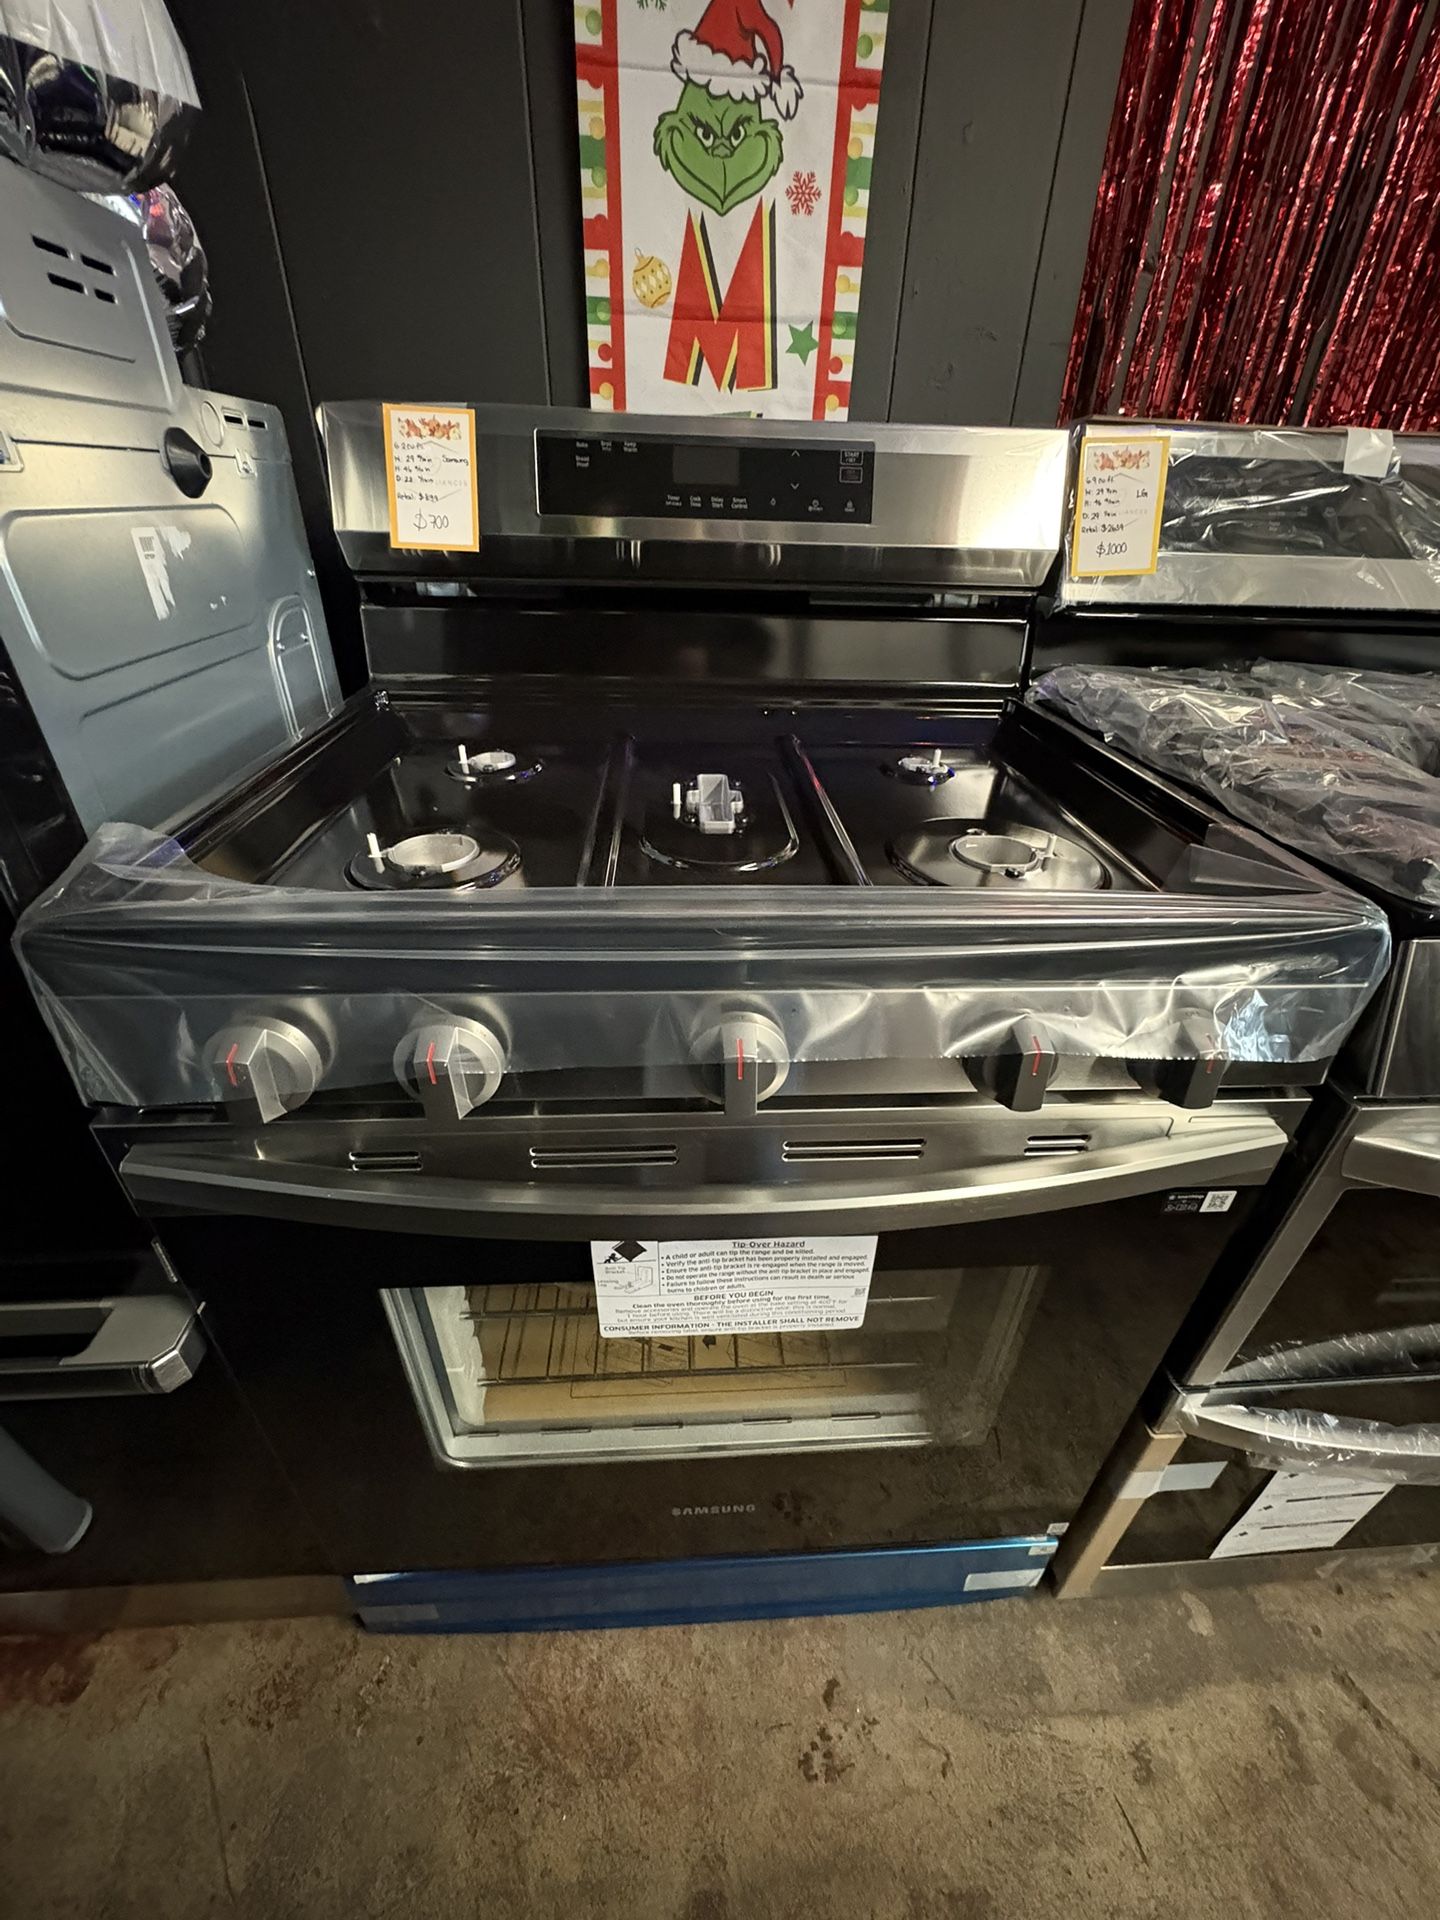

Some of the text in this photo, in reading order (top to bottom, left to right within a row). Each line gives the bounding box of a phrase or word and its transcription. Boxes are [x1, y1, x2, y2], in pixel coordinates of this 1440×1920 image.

[663, 195, 778, 393] M
[1136, 488, 1148, 498] LG
[413, 507, 449, 531] $700
[1096, 541, 1127, 558] $1000
[749, 1290, 774, 1298] BEGIN
[672, 1504, 755, 1516] SAMSUNG
